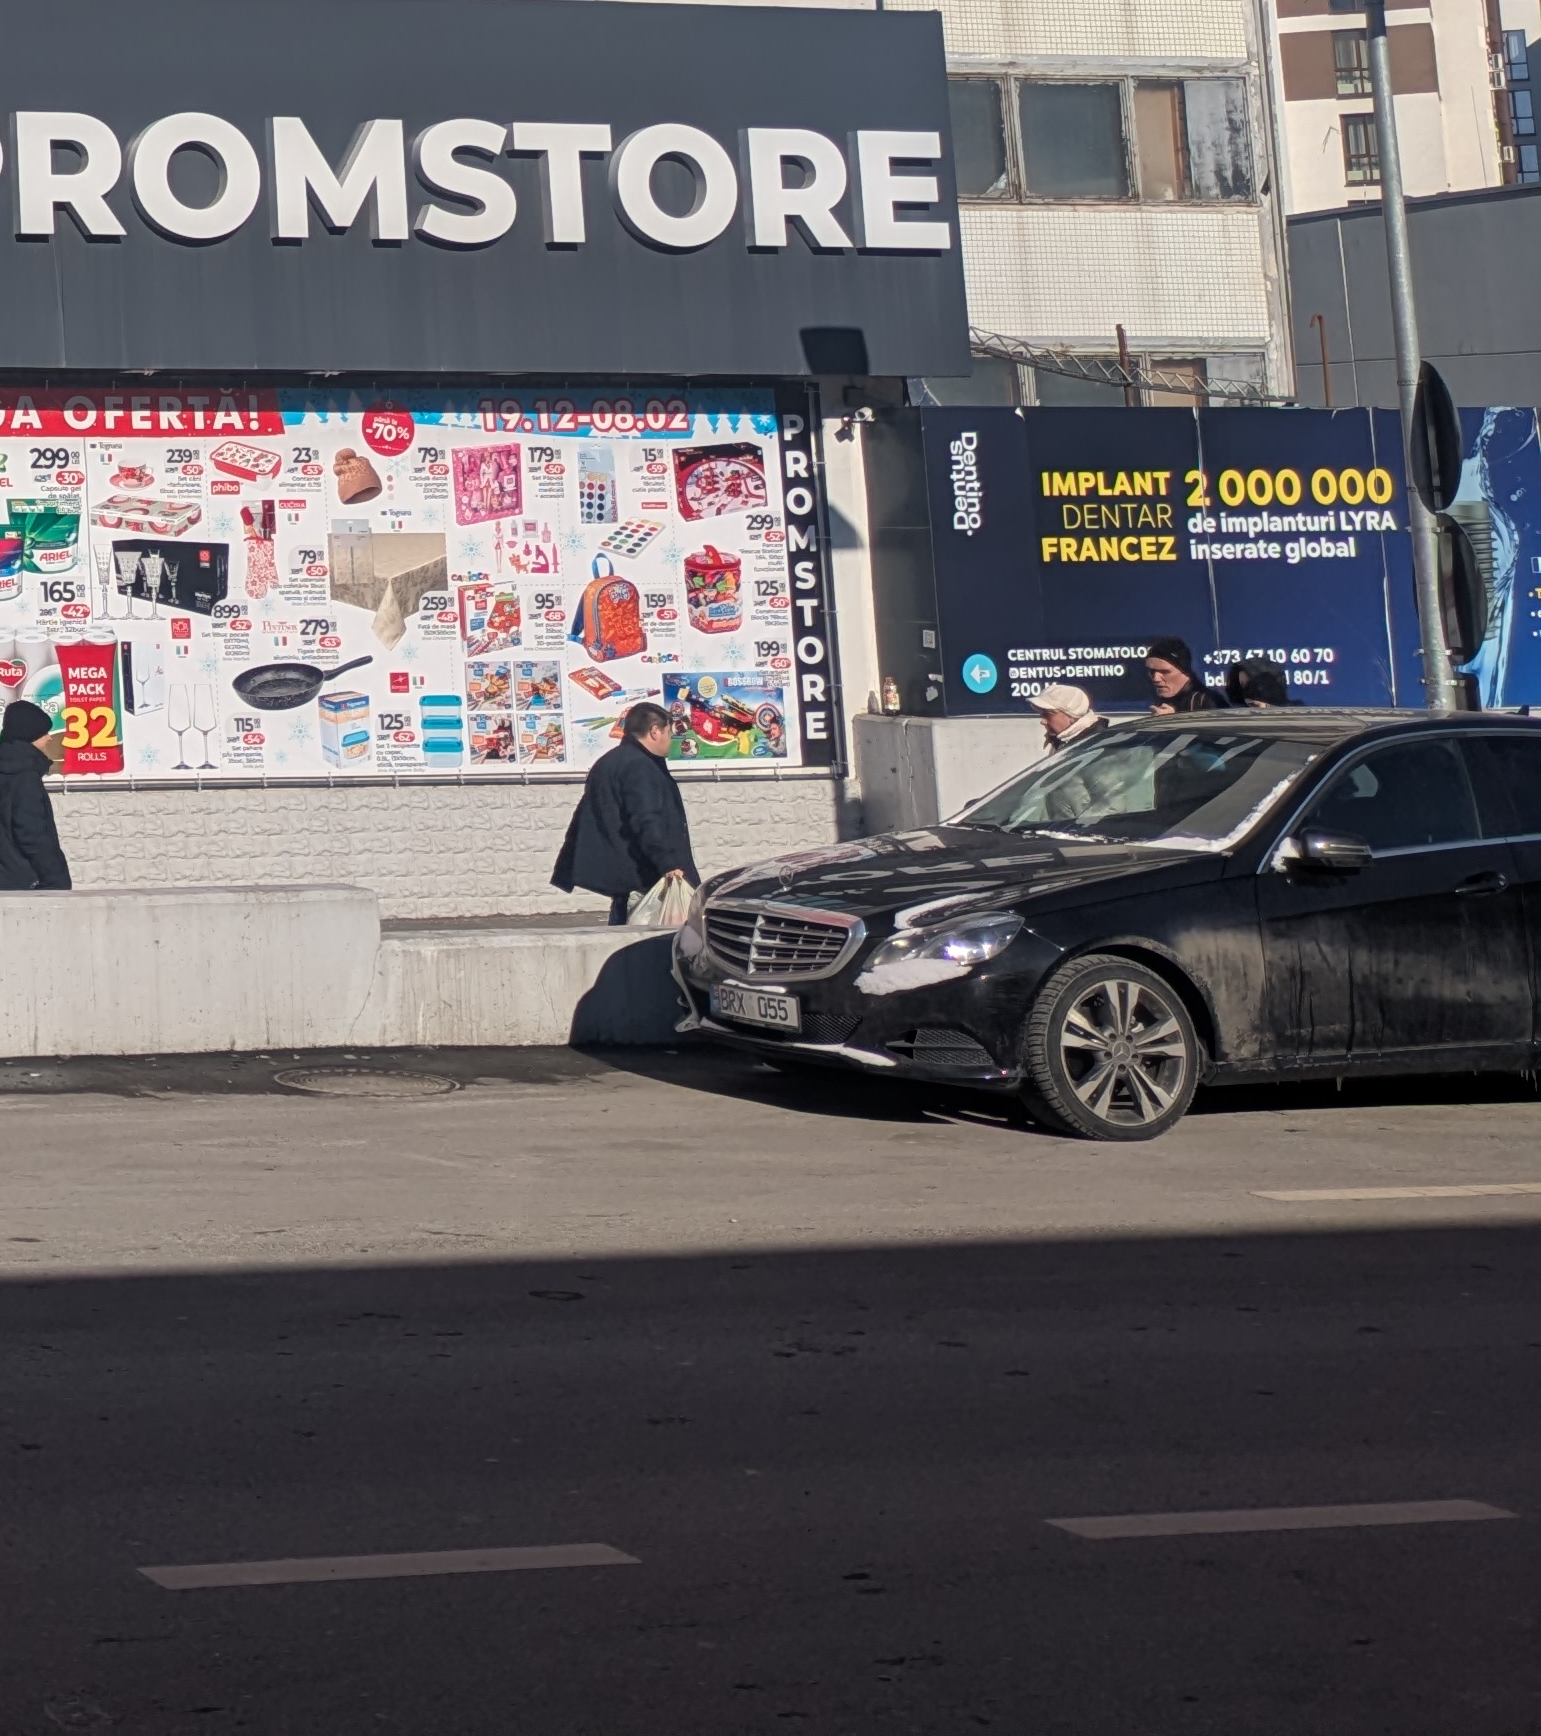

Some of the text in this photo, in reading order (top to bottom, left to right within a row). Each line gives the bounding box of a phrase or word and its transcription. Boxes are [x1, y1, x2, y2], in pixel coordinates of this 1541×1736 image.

[63, 389, 260, 430] OFERTĂ!
[478, 397, 689, 432] 19.12-08.02
[366, 424, 410, 441] -70%
[30, 448, 69, 469] 299
[167, 449, 193, 463] 239
[293, 448, 312, 463] 23
[418, 447, 438, 463] 79
[528, 447, 554, 463] 179
[642, 448, 657, 462] 15
[213, 483, 239, 494] phibo
[950, 440, 970, 530] Dentus
[1042, 471, 1170, 496] IMPLANT
[1184, 468, 1392, 507] 2 000 000
[746, 515, 774, 530] 299
[1063, 503, 1173, 529] DENTAR
[1187, 511, 1397, 538] de implanturi LYRA
[40, 551, 72, 561] ARIEL
[298, 550, 316, 564] 79
[1042, 536, 1177, 562] FRANCEZ
[1190, 537, 1357, 564] inserate global
[782, 414, 828, 740] PROMSTORE
[40, 581, 77, 602] 165
[754, 581, 779, 596] 125
[422, 596, 447, 610] 259
[535, 593, 555, 610] 95
[644, 594, 666, 607] 159
[214, 604, 240, 618] 899
[299, 619, 329, 635] 279
[754, 641, 780, 657] 199
[1008, 646, 1151, 661] CENTRUL STOMATOLO
[1204, 649, 1240, 664] +373
[1267, 649, 1286, 663] 10
[1290, 649, 1310, 663] 60
[1313, 648, 1334, 663] 70
[641, 653, 678, 663] CARIOCA
[68, 667, 107, 679] MEGA
[1204, 671, 1227, 687] bd.
[1293, 670, 1330, 685] 80/1
[69, 684, 105, 695] PACK
[1011, 682, 1041, 697] 200
[61, 707, 118, 748] 32
[234, 718, 253, 731] 115
[378, 714, 404, 730] 125
[77, 752, 107, 761] ROLLS
[720, 989, 789, 1021] BRX 055
